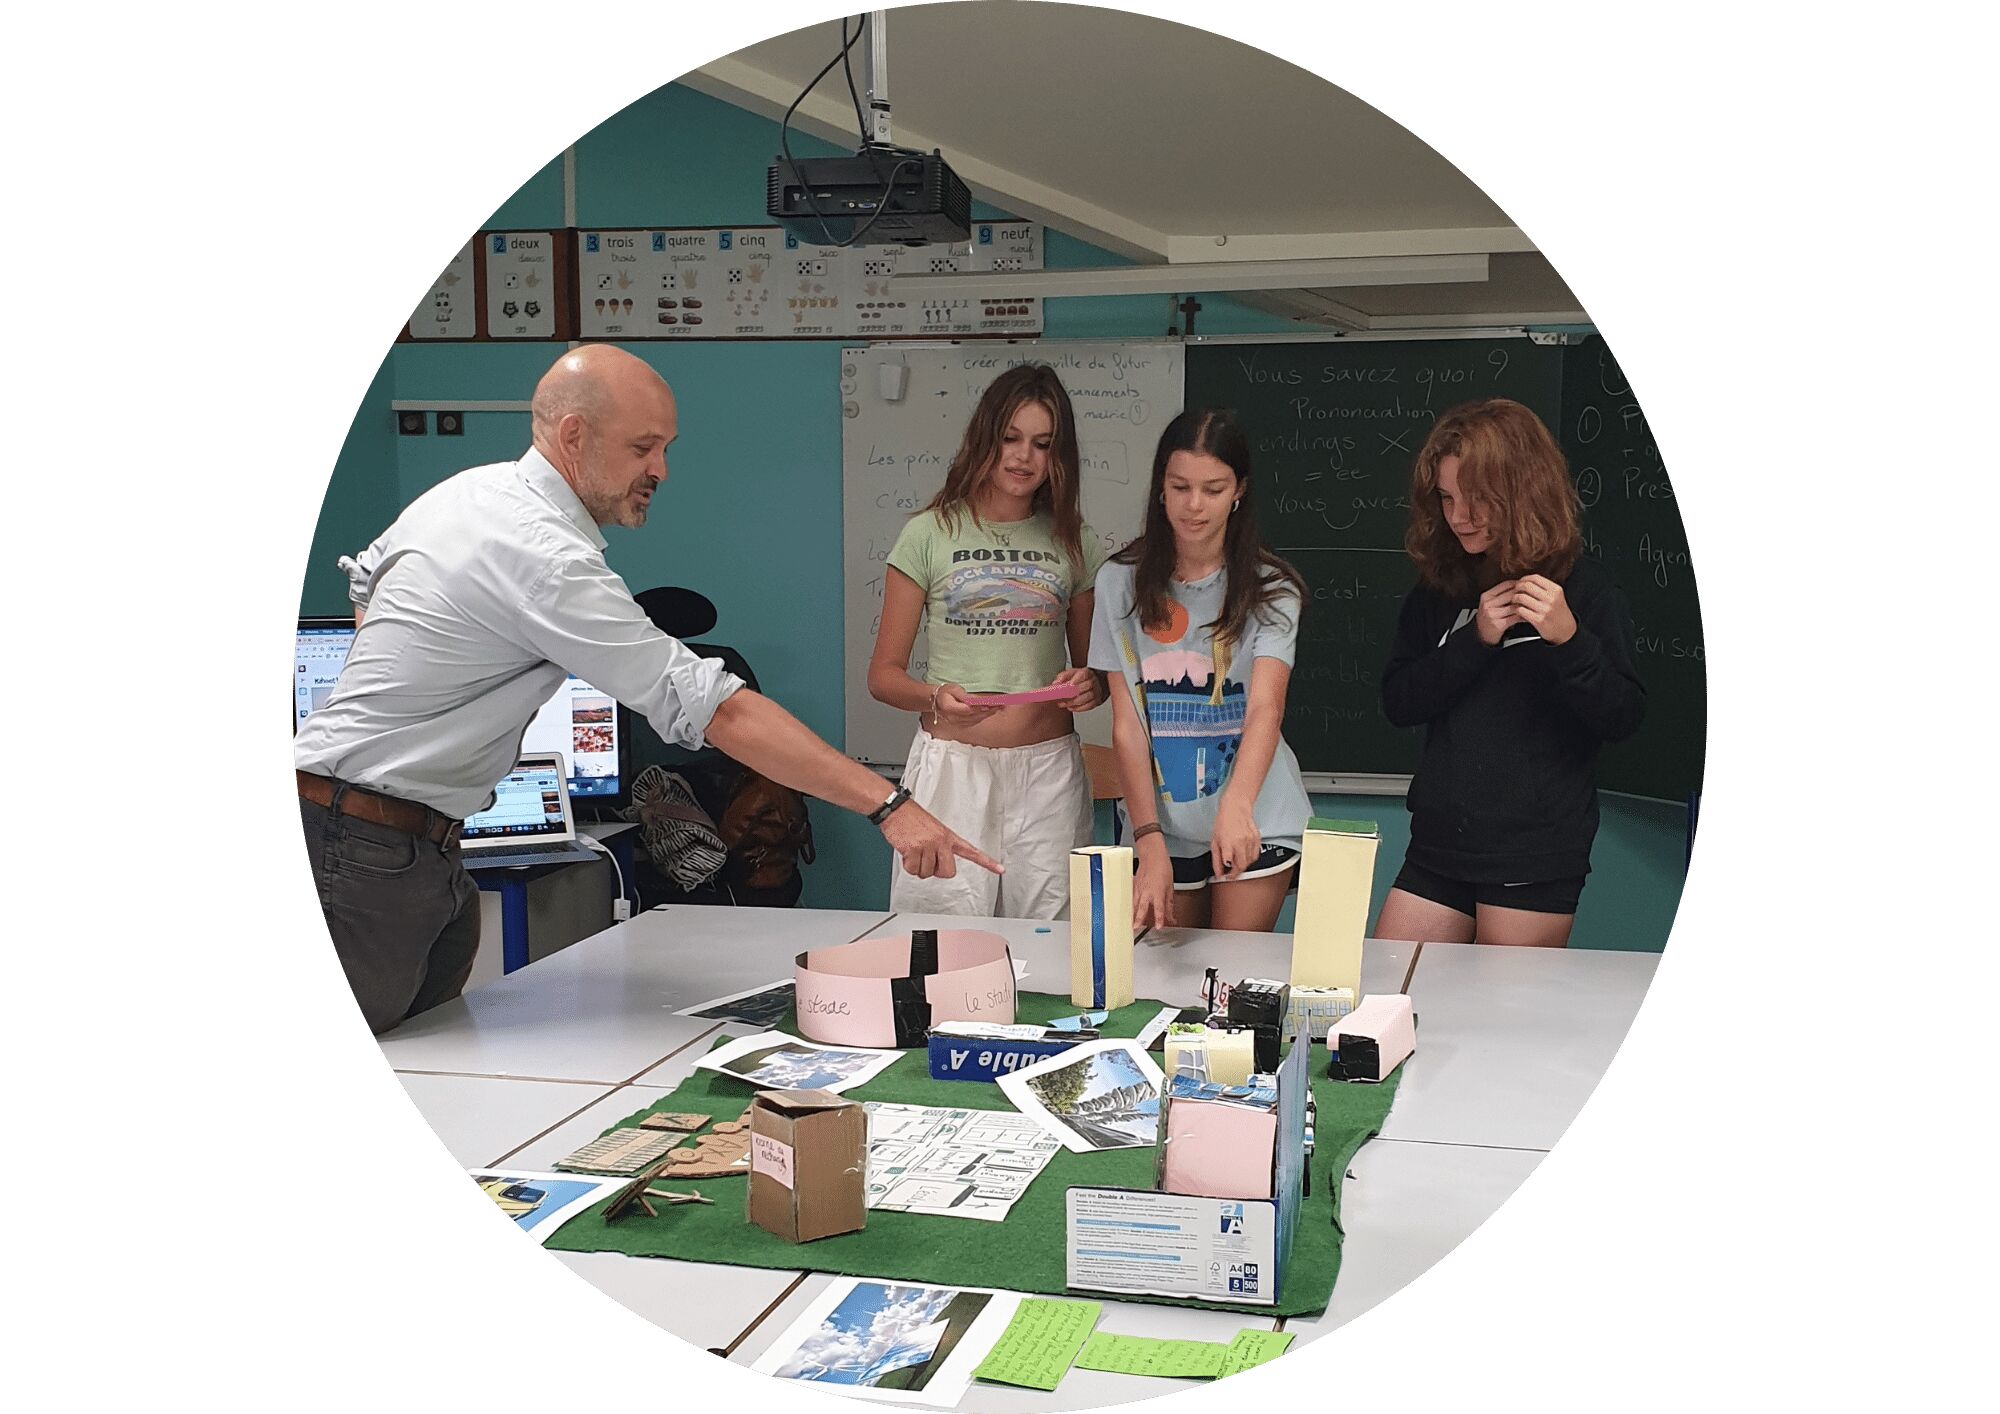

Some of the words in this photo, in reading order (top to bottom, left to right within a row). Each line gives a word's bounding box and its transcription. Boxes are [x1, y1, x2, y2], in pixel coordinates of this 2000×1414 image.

[588, 235, 598, 251] 3
[607, 236, 634, 249] trois
[654, 234, 664, 251] 4
[668, 235, 706, 251] quatre
[722, 233, 731, 251] 5
[739, 233, 766, 249] cinq
[980, 226, 992, 243] 9
[1001, 227, 1031, 240] neuf
[496, 236, 505, 254] 2
[511, 237, 540, 250] deux
[963, 352, 999, 371] créer
[1050, 354, 1081, 370] ville
[1088, 355, 1107, 369] du
[1111, 352, 1152, 381] futur
[1239, 350, 1303, 385] Vous
[1321, 365, 1400, 385] savez
[1415, 364, 1476, 407] quoi
[867, 444, 895, 467] Les
[906, 450, 940, 476] prix
[1274, 491, 1328, 515] Vous
[952, 549, 1062, 565] BOSTON
[991, 566, 1028, 576] AND
[966, 627, 996, 636] 1979
[1000, 627, 1039, 636] TOUR
[986, 618, 1030, 628] LOOK
[807, 993, 851, 1016] stade
[964, 991, 982, 1014] le
[1229, 1264, 1243, 1273] A4
[1245, 1265, 1257, 1275] 80
[1244, 1280, 1258, 1290] 500
